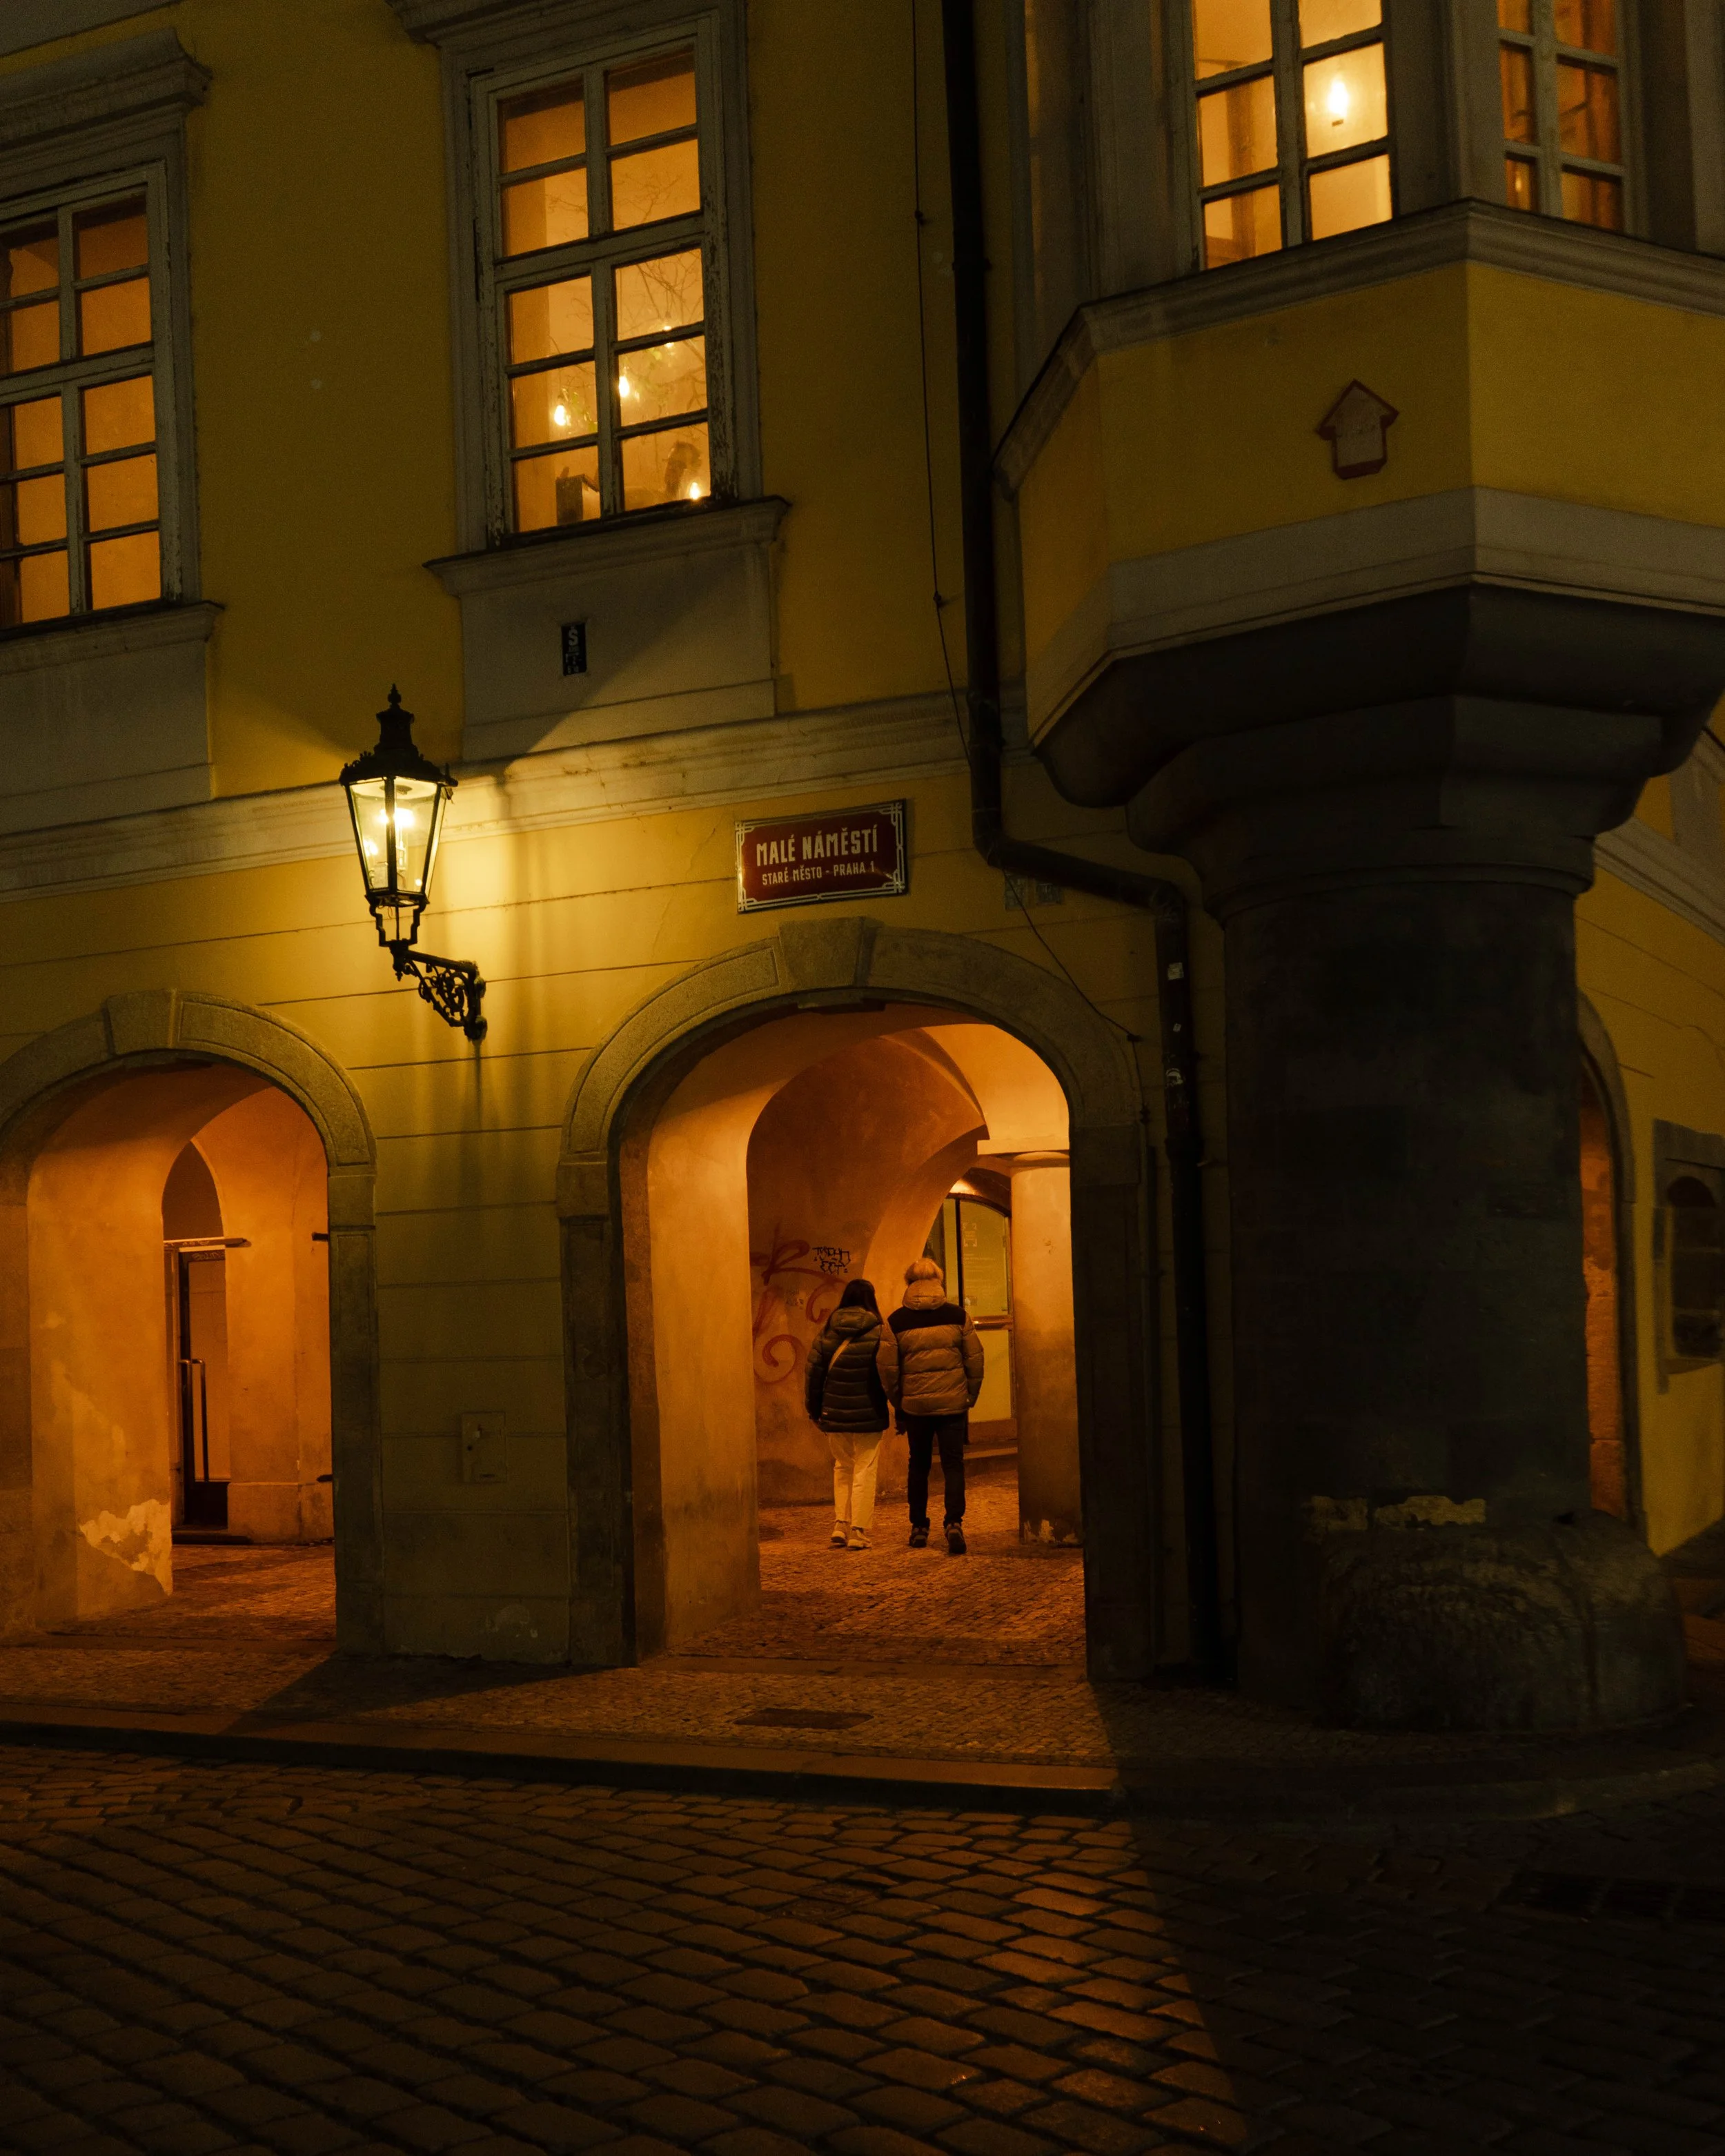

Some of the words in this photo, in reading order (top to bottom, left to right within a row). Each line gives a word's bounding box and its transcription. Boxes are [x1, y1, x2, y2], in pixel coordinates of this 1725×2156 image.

[756, 833, 796, 867] MALÉ
[802, 824, 878, 860] NÁMĚSTÍ
[762, 867, 789, 886] STARÉ
[793, 863, 822, 881] MĚSTO
[834, 862, 865, 877] PRAHA
[869, 860, 875, 873] 1
